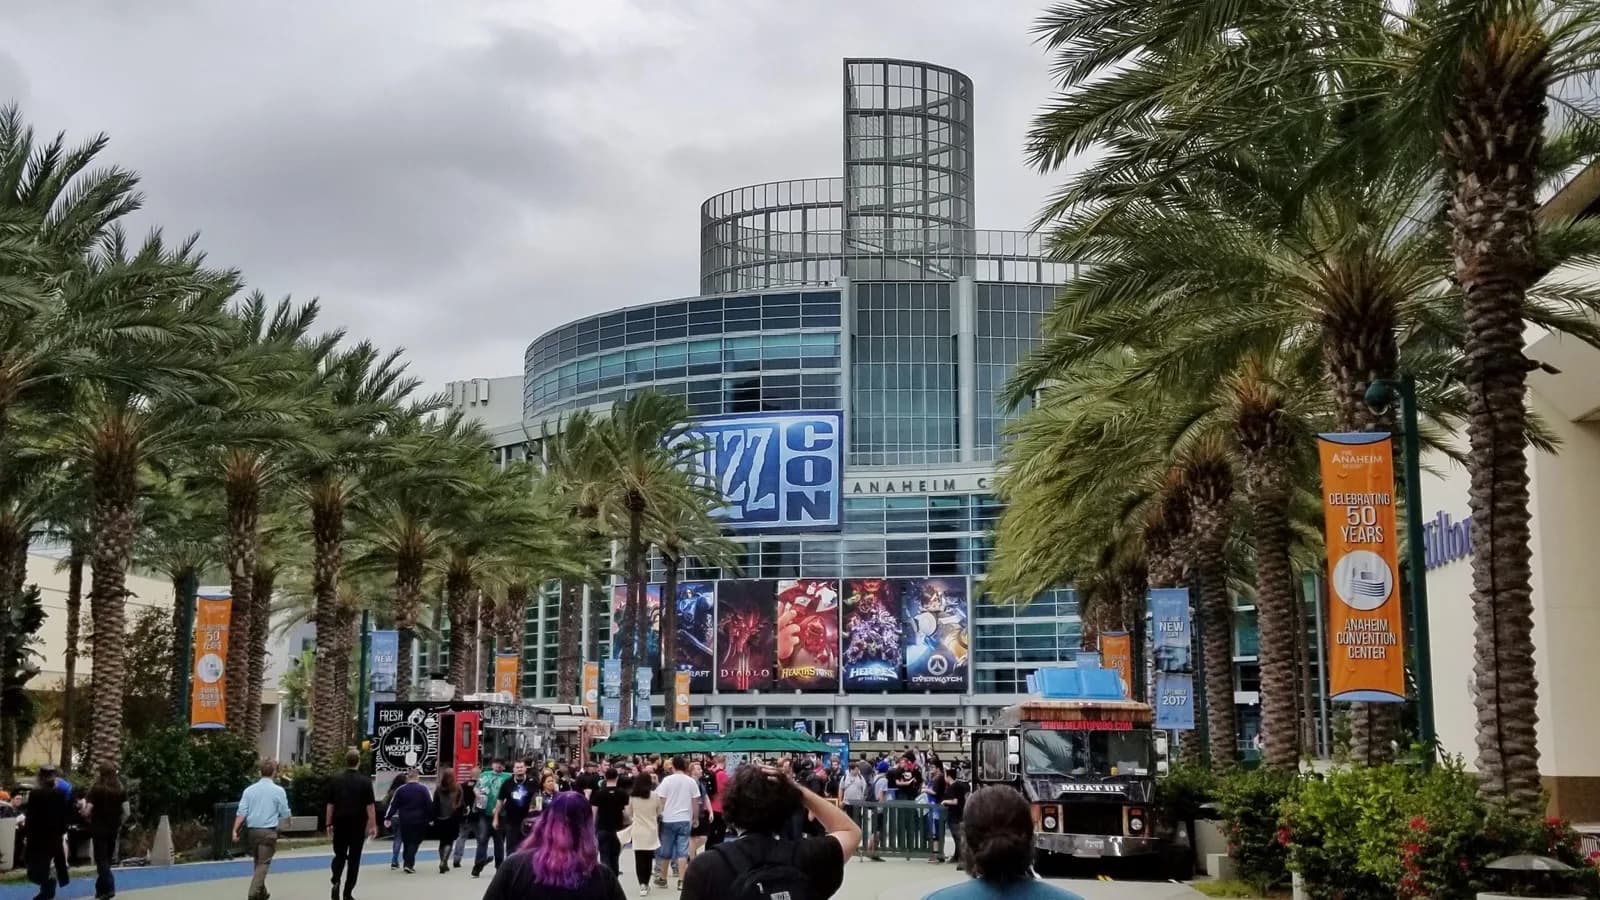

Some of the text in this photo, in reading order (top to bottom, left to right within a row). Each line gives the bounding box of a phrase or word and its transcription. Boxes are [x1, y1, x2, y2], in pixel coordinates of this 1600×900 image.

[1332, 453, 1383, 464] ANAHEIM
[786, 421, 834, 521] CON
[853, 479, 956, 493] ANAHEIM
[1329, 493, 1390, 505] CELEBRATING
[1347, 506, 1377, 526] 50
[1341, 526, 1384, 543] YEARS
[1160, 622, 1184, 632] NEW
[1345, 618, 1388, 631] ANAHEIM
[1337, 632, 1396, 645] CONVENTION
[1348, 646, 1386, 659] CENTER
[375, 655, 393, 663] NEW
[721, 669, 770, 677] DIABLO
[911, 675, 963, 684] OVERWATCH
[1162, 695, 1187, 705] 2017
[380, 710, 403, 721] FRESH
